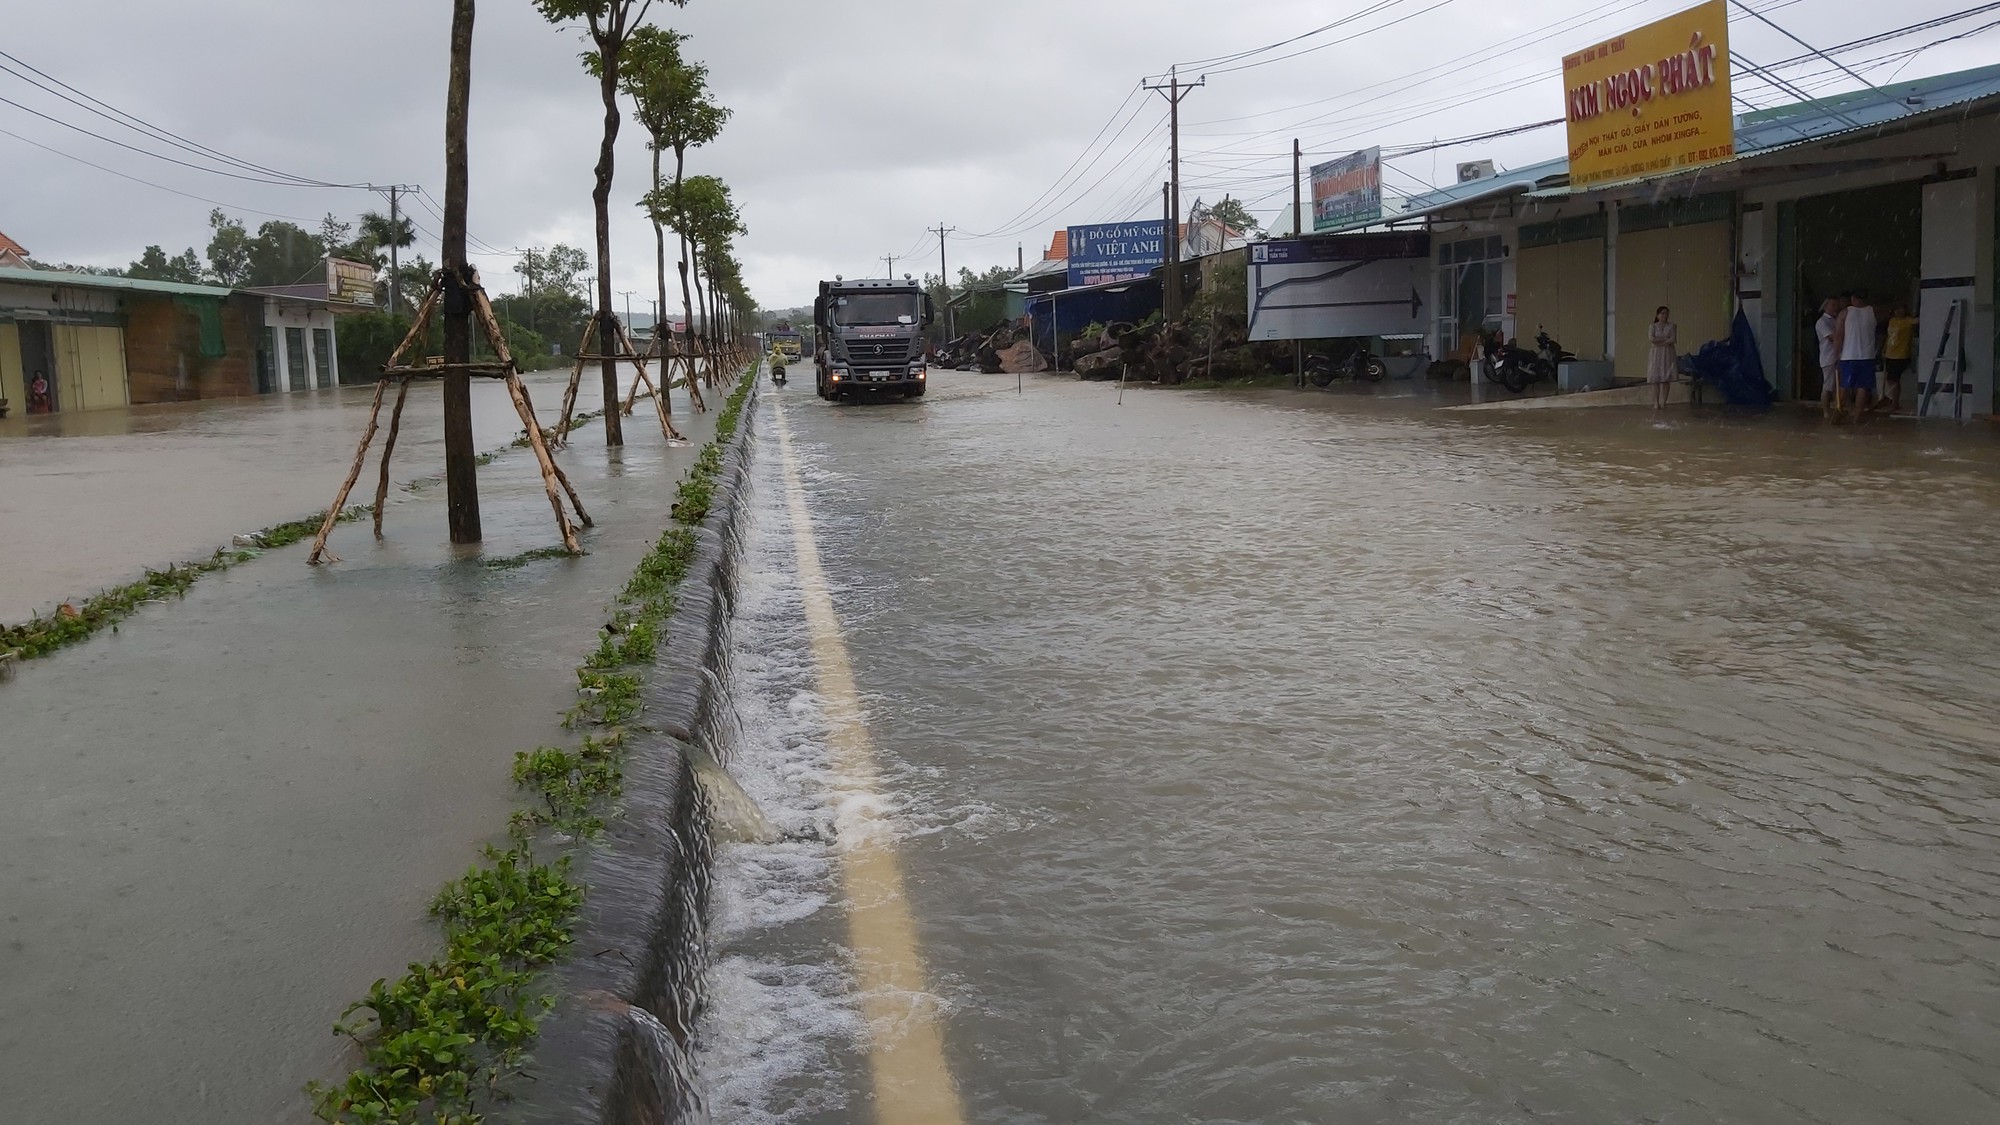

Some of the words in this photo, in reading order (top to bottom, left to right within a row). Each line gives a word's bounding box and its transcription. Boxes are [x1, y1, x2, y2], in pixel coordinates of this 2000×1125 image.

[1569, 81, 1602, 122] KIM
[1605, 64, 1656, 118] NGỌC
[1658, 31, 1716, 97] PHÁT
[1089, 227, 1104, 240] ĐỒ
[1123, 225, 1139, 237] MỸ
[1141, 225, 1165, 236] NGH
[1096, 240, 1127, 258] VIỆT
[1131, 240, 1160, 254] ANH
